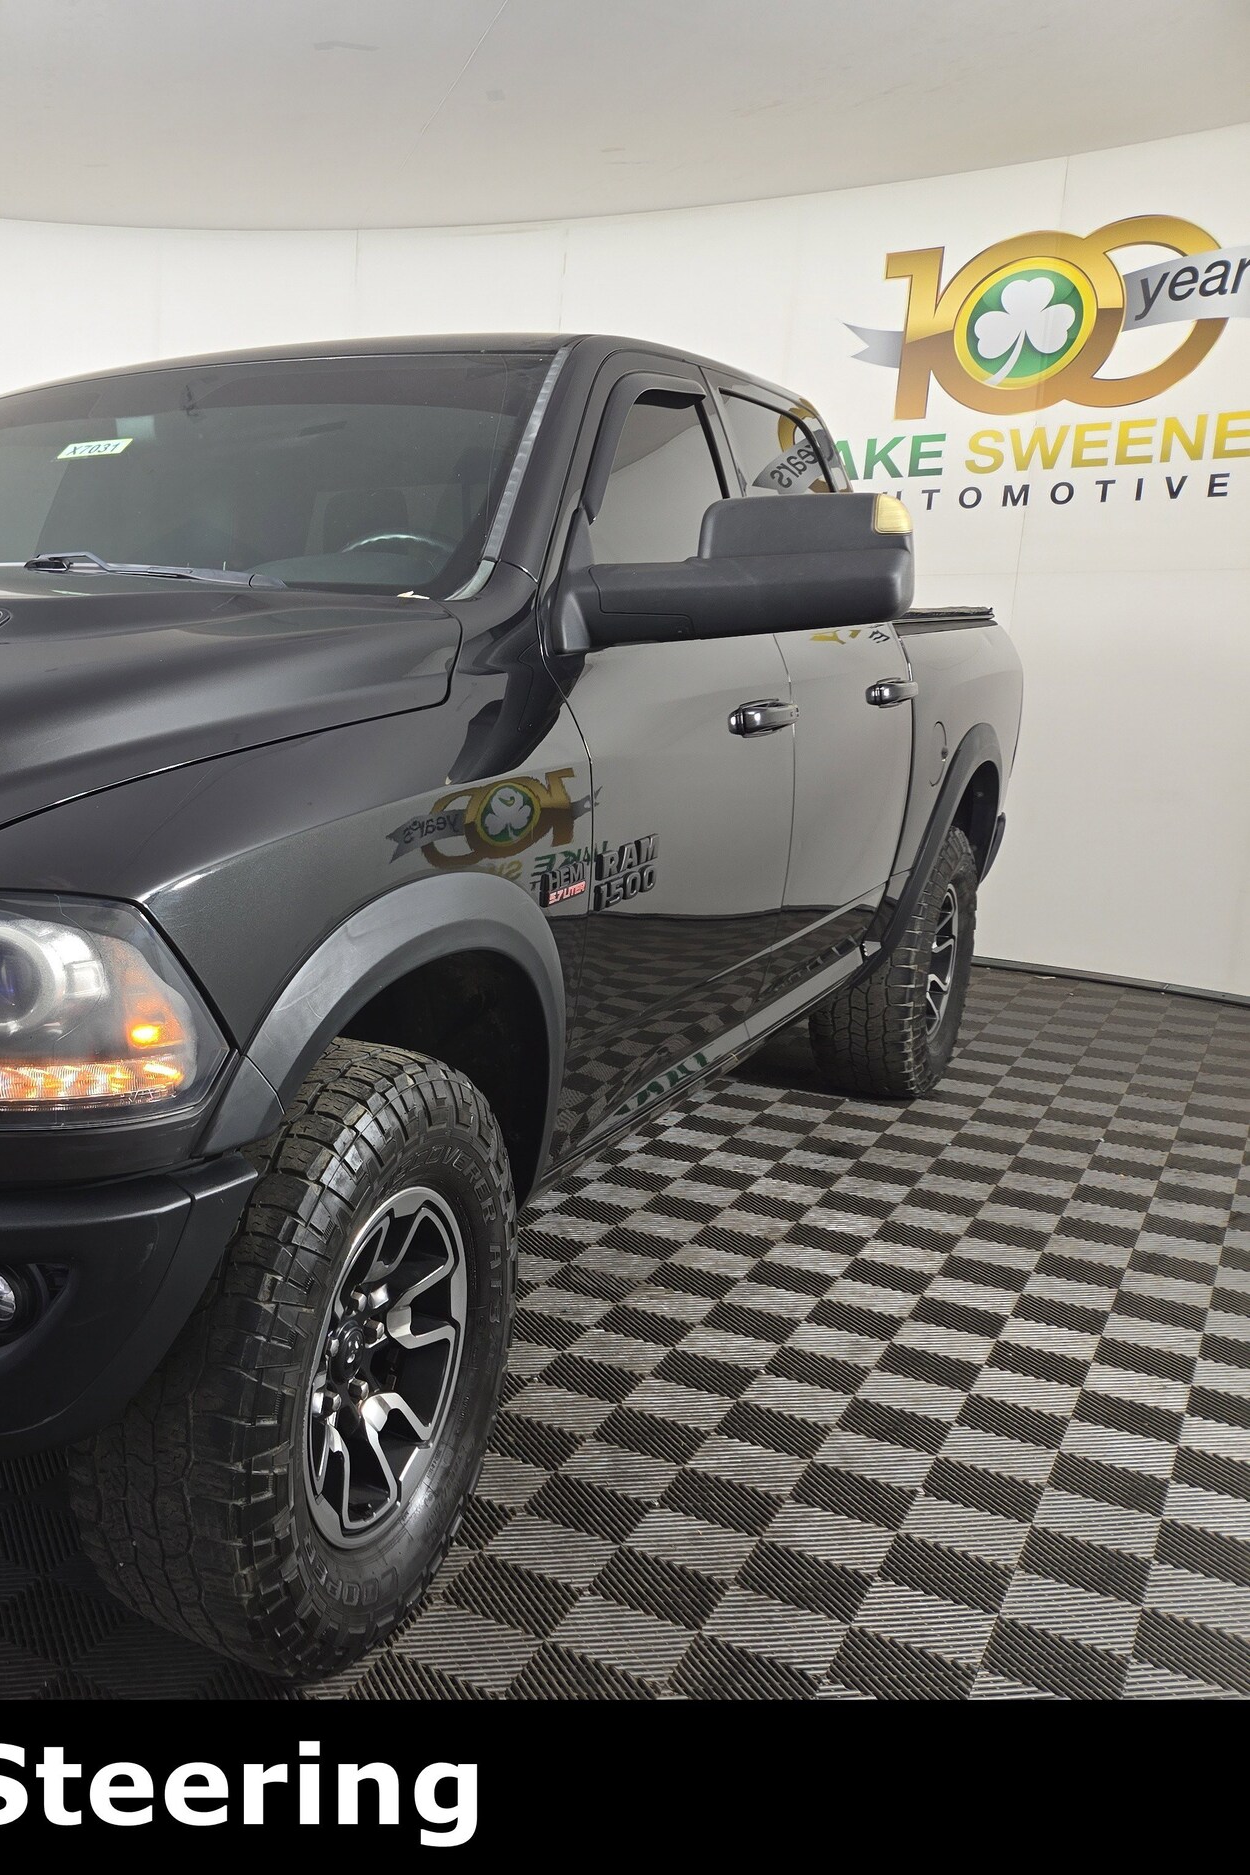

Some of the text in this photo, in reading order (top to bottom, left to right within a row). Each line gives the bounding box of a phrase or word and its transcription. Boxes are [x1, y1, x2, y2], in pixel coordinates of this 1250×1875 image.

[1134, 257, 1250, 321] year
[66, 442, 120, 457] X7031
[833, 410, 1250, 481] AKE SWEENE
[883, 472, 1230, 512] TOMOTIVE
[547, 861, 587, 890] HEMI
[599, 833, 661, 879] RAM
[563, 881, 587, 899] LITER
[596, 864, 657, 911] 1500
